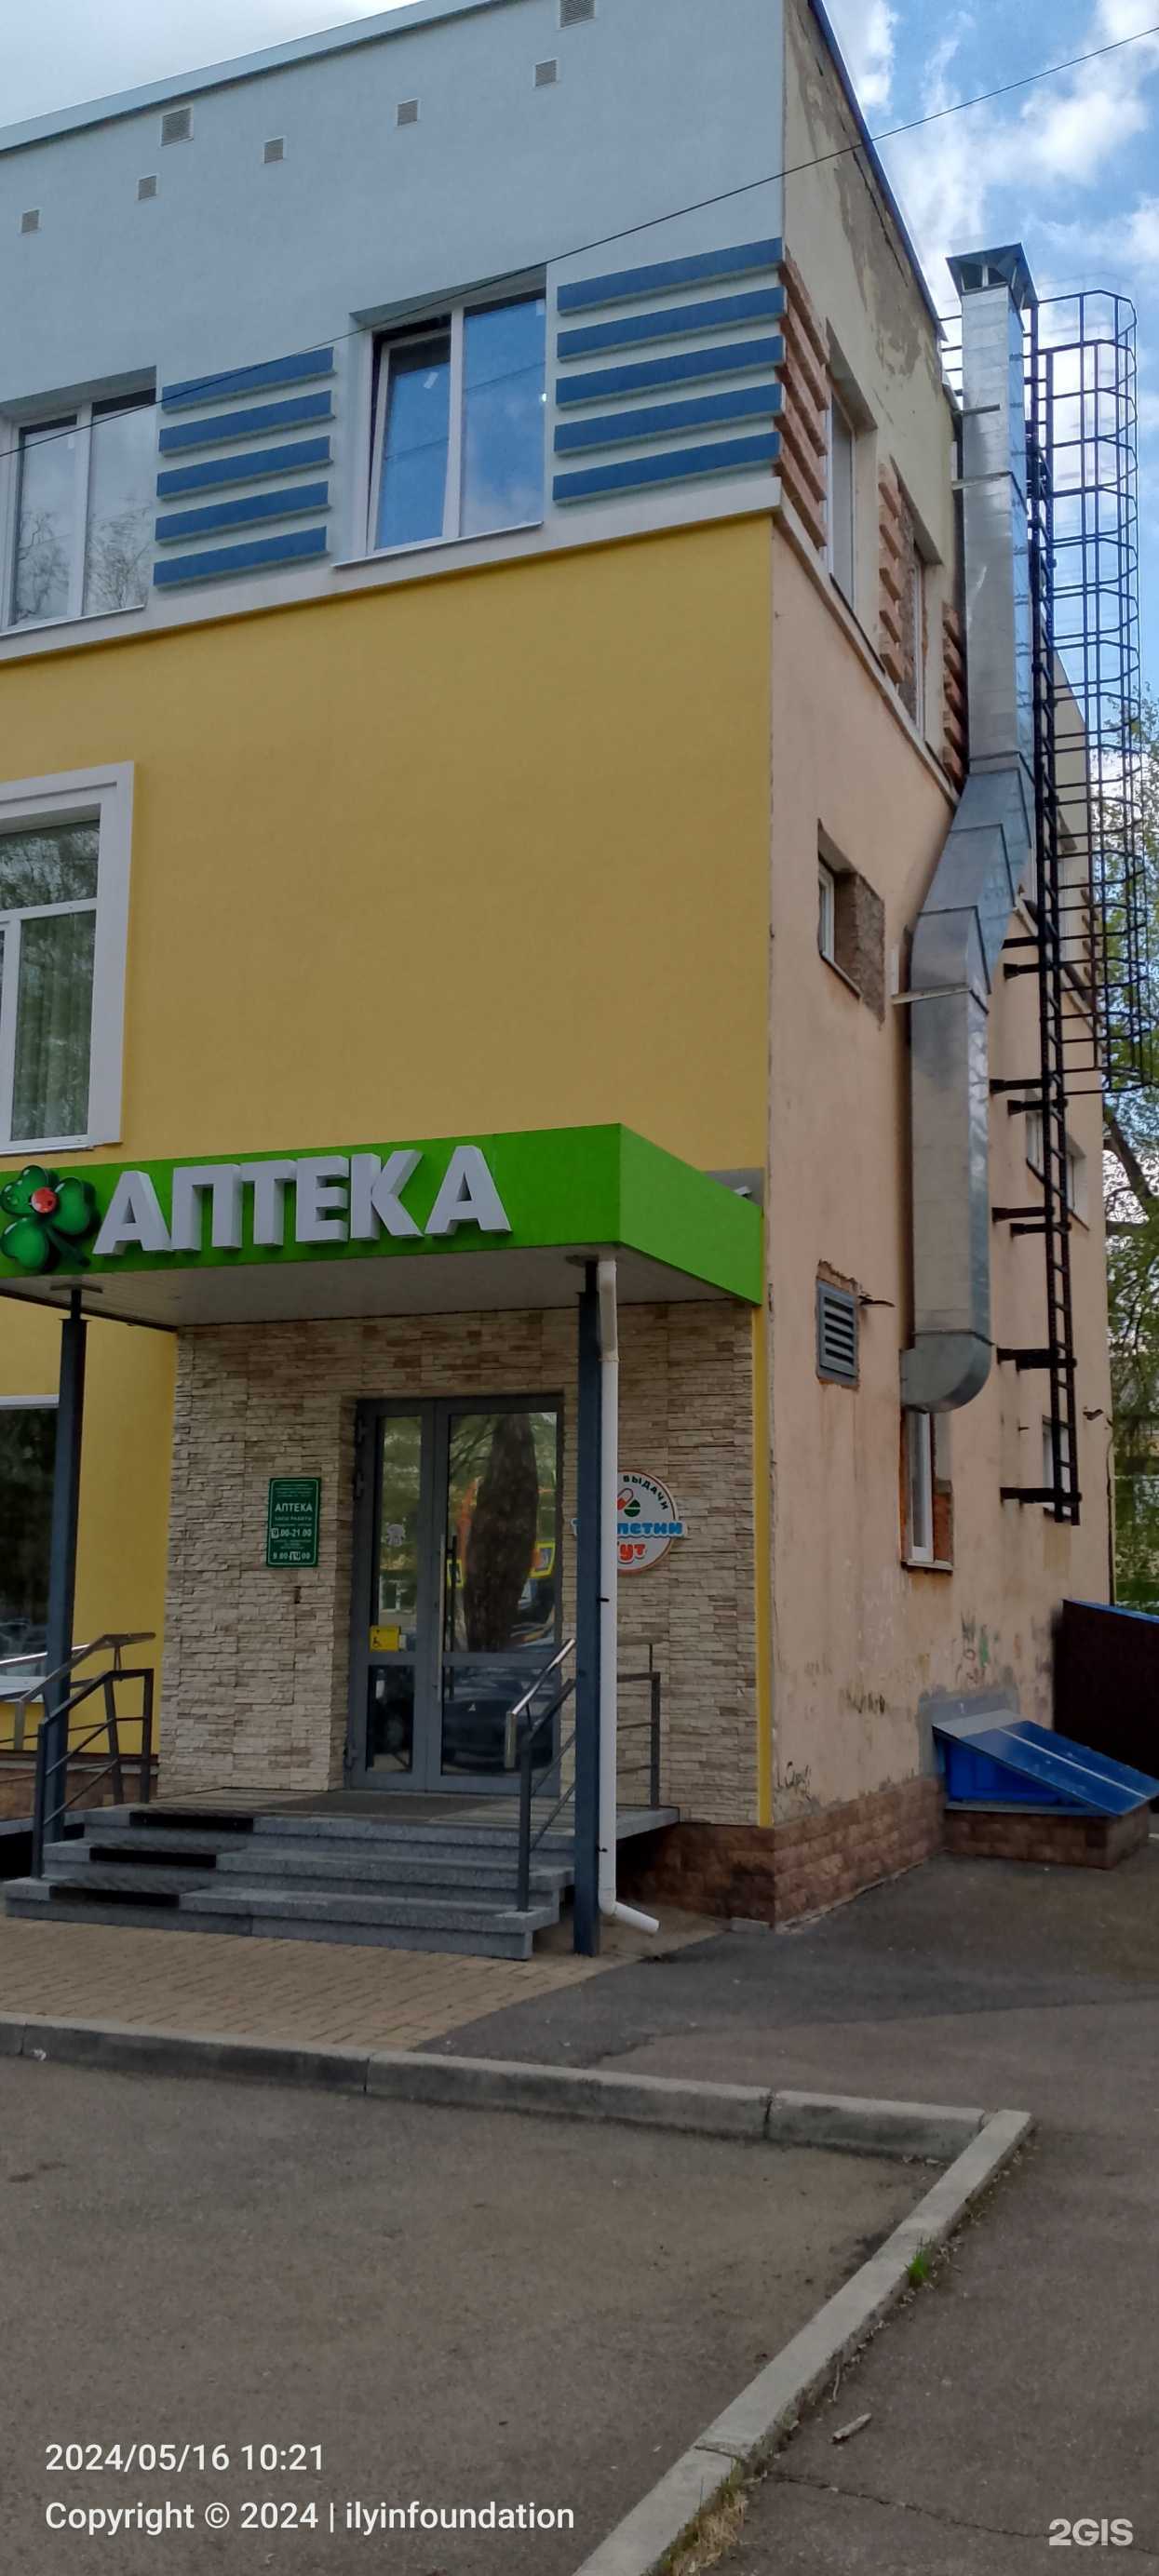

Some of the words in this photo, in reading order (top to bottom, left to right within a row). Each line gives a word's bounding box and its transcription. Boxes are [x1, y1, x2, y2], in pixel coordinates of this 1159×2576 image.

[93, 1145, 513, 1256] АПТЕКА
[275, 1503, 313, 1512] АПТЕКА
[623, 1475, 669, 1510] ВЫДАЧИ
